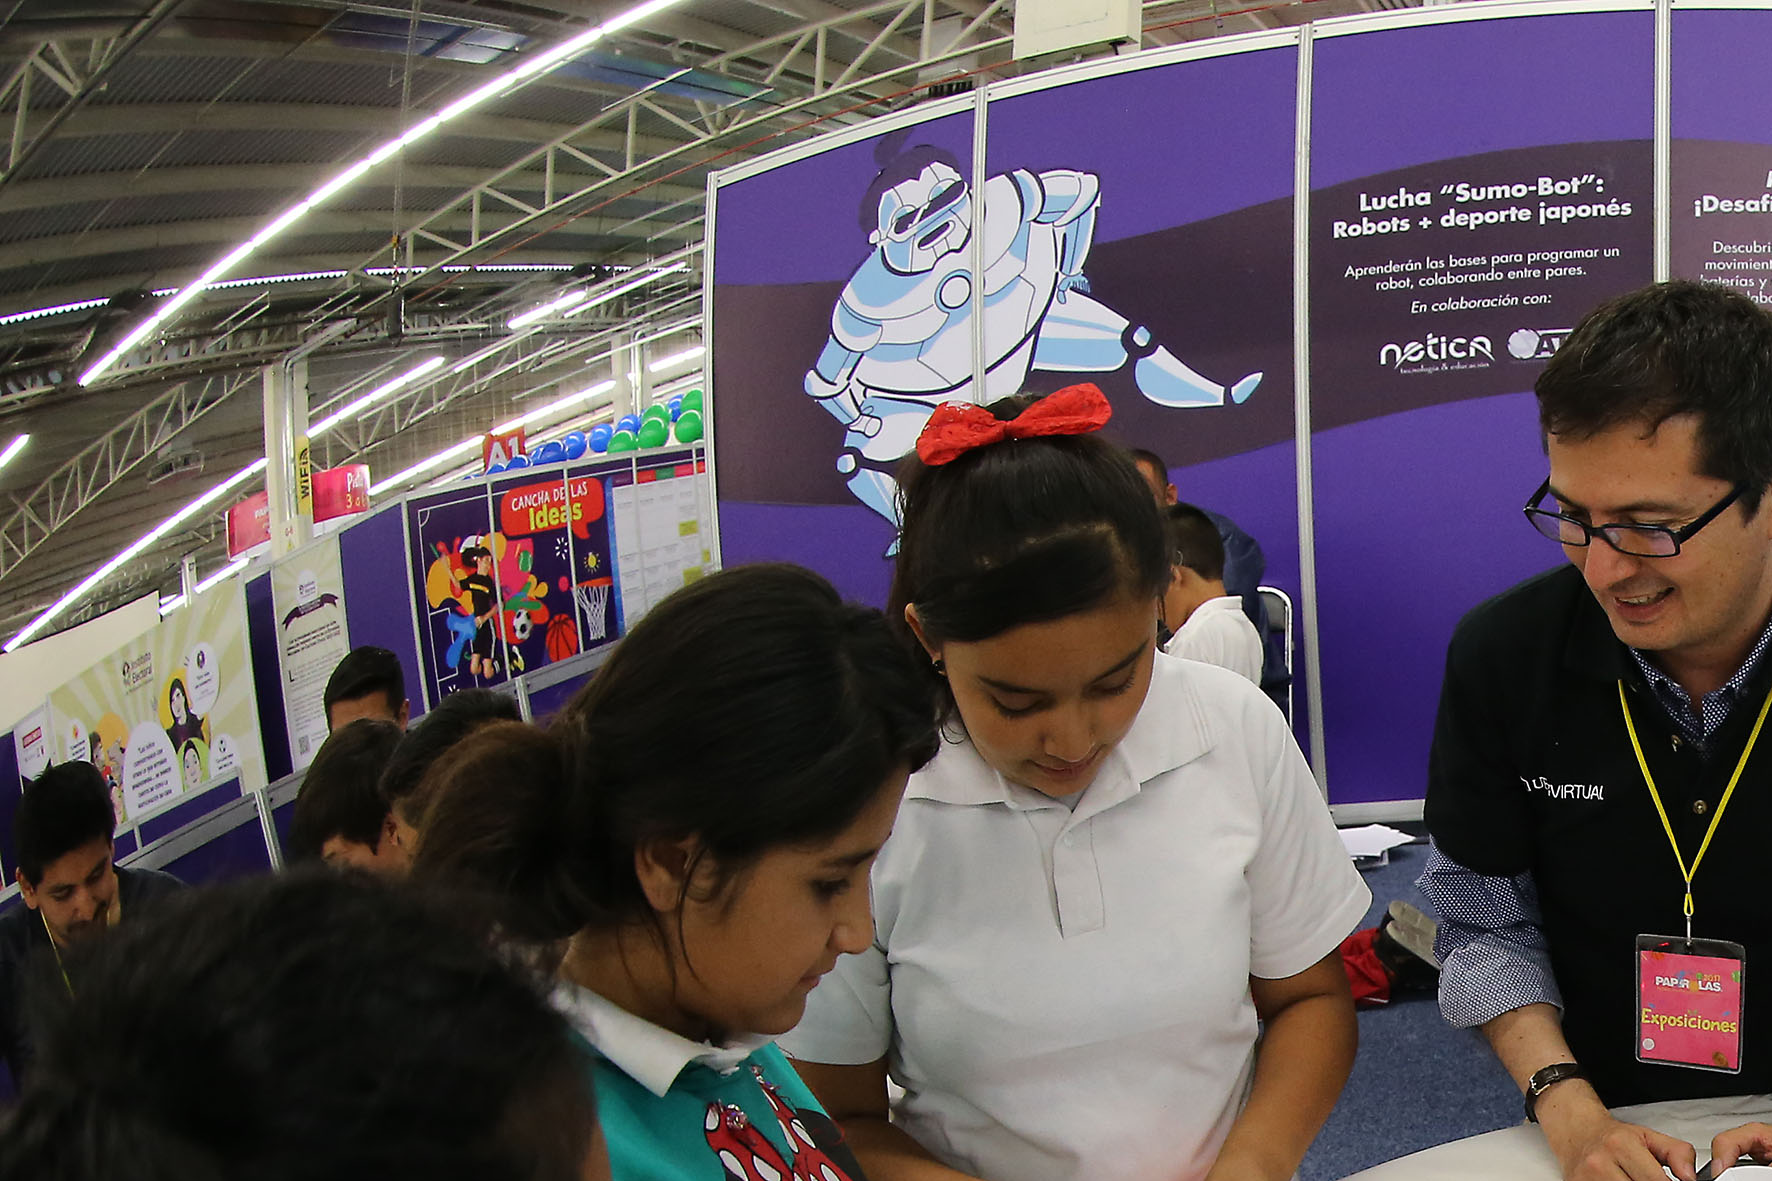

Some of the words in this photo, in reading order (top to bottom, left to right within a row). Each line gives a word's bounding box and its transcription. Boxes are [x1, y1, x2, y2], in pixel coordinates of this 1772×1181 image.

[1359, 187, 1432, 212] Lucha
[1333, 216, 1411, 239] Robots
[1440, 206, 1532, 231] deporte
[1539, 197, 1632, 225] japonés
[1344, 259, 1422, 280] Aprenderán
[1426, 256, 1445, 269] las
[1449, 254, 1487, 267] bases
[1491, 253, 1523, 267] para
[1527, 249, 1599, 264] programar
[1603, 247, 1620, 257] un
[1375, 276, 1414, 291] robot,
[1418, 268, 1503, 287] colaborando
[1507, 267, 1541, 280] entre
[1545, 266, 1587, 280] pares.
[1759, 279, 1768, 290] y
[1410, 301, 1427, 314] En
[1431, 293, 1519, 312] colaboración
[1522, 294, 1552, 306] con:
[487, 437, 521, 468] A1
[511, 489, 550, 511] CANCHA
[571, 481, 588, 498] LAS
[529, 501, 583, 531] Ideas
[1641, 1007, 1738, 1033] Exposiciones
